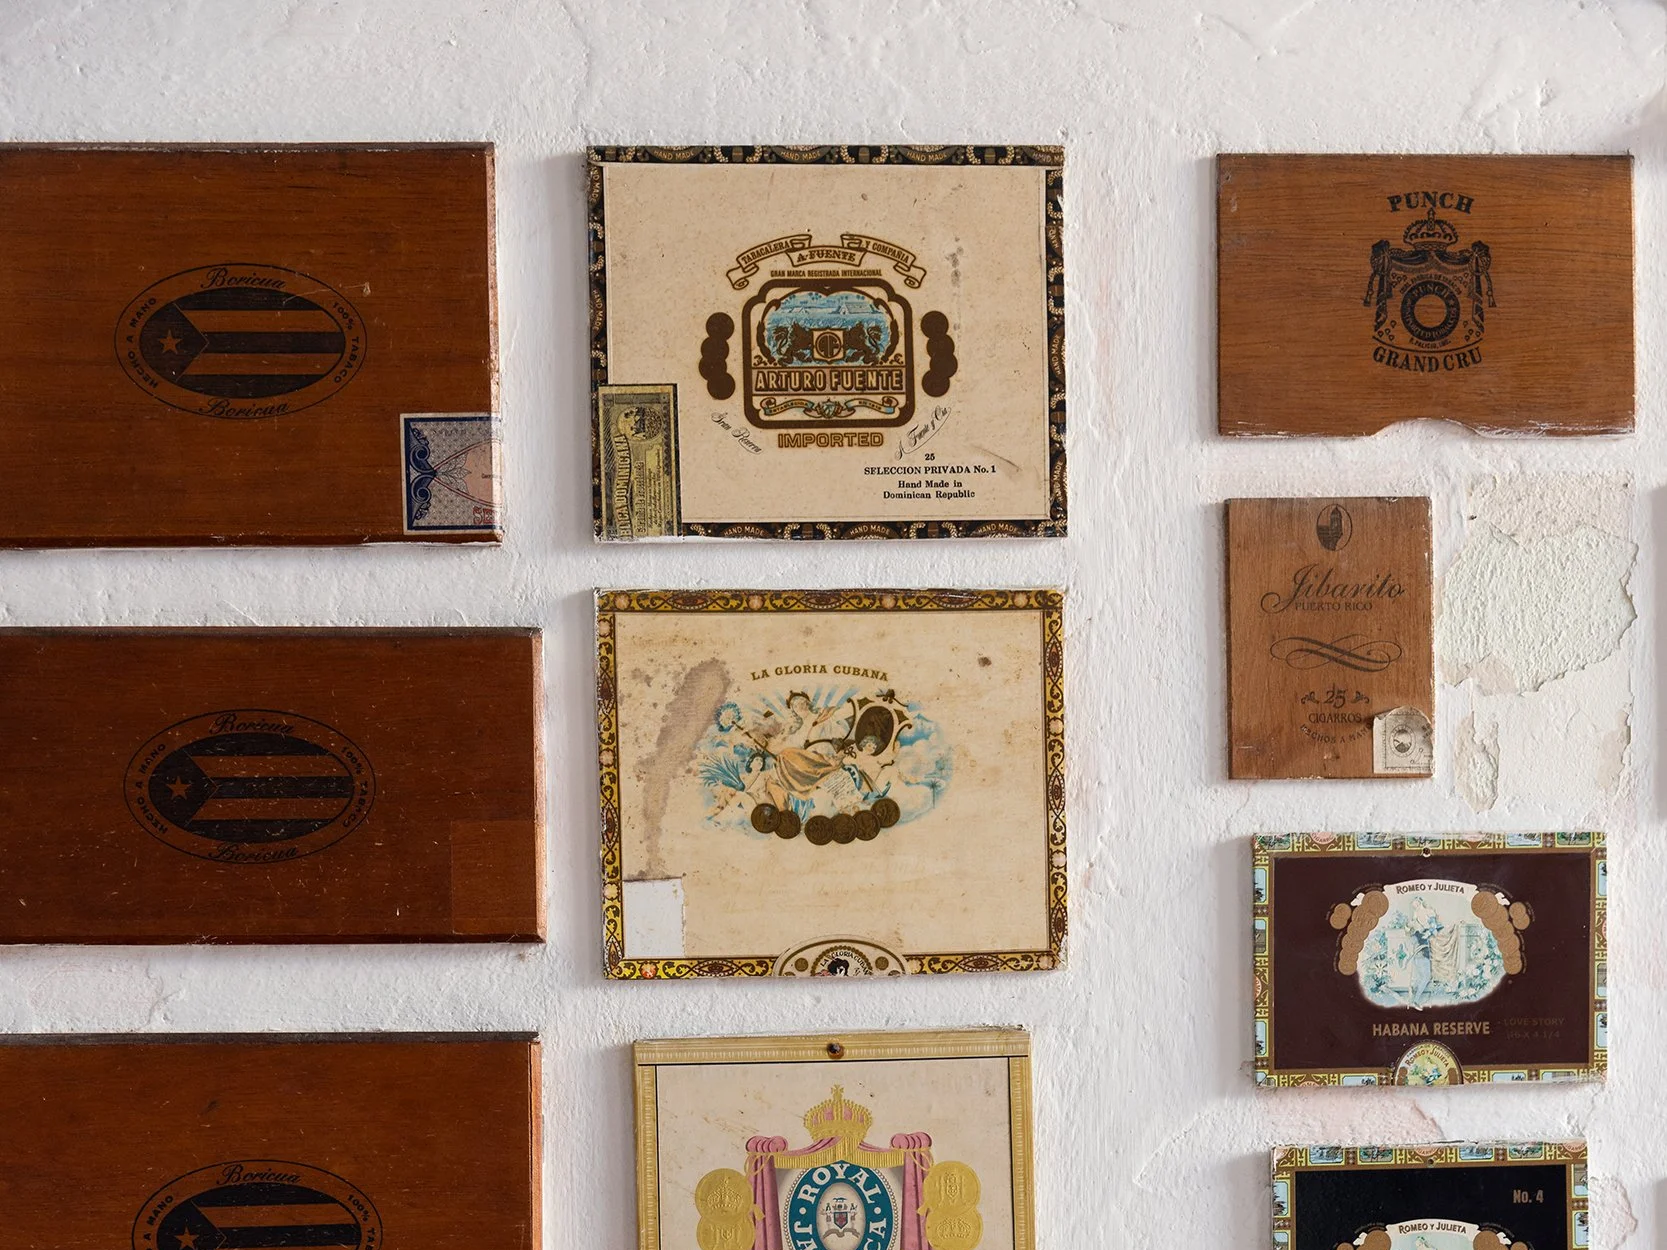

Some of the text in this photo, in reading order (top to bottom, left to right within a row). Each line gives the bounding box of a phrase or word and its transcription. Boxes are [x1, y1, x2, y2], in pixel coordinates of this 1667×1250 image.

[654, 149, 695, 160] HAND MADE
[781, 150, 821, 161] HAND MADE
[907, 151, 926, 162] HAND
[1387, 191, 1475, 214] PUNCH
[741, 240, 790, 265] TABACALERA
[201, 267, 287, 289] Boricua
[770, 269, 882, 278] GRAN MARCA REGISTRADA INTERNACIONAL
[127, 297, 159, 388] HECHO A MANO
[332, 301, 360, 385] 100% TABACO
[1373, 346, 1482, 373] GRAND CRU
[755, 370, 903, 391] ARTURO FUENTE
[199, 398, 290, 417] Boricua
[778, 432, 884, 448] IMPORTED
[924, 453, 935, 461] 25
[864, 465, 996, 475] SELECCION PRIVADA No. 1
[898, 480, 963, 489] Hand Made in
[883, 490, 975, 500] Dominican Republic
[1260, 563, 1406, 613] Jibarito
[1295, 602, 1373, 611] PUERTO RICO
[750, 664, 889, 681] LA GLORIA CUBANA
[1324, 688, 1347, 709] 25
[209, 713, 296, 734] Boricua
[1309, 713, 1361, 723] CIGARROS
[135, 781, 143, 789] A
[136, 796, 168, 834] HECHO
[208, 843, 299, 862] Boricua
[1373, 1023, 1429, 1037] HABANA
[1433, 1021, 1490, 1036] RESERVE
[216, 1164, 302, 1185] Boricua
[798, 1163, 882, 1204] ROYAL
[1513, 1190, 1544, 1204] No. 4
[146, 1195, 174, 1226] MANO
[347, 1194, 369, 1222] 100%
[144, 1232, 151, 1241] A
